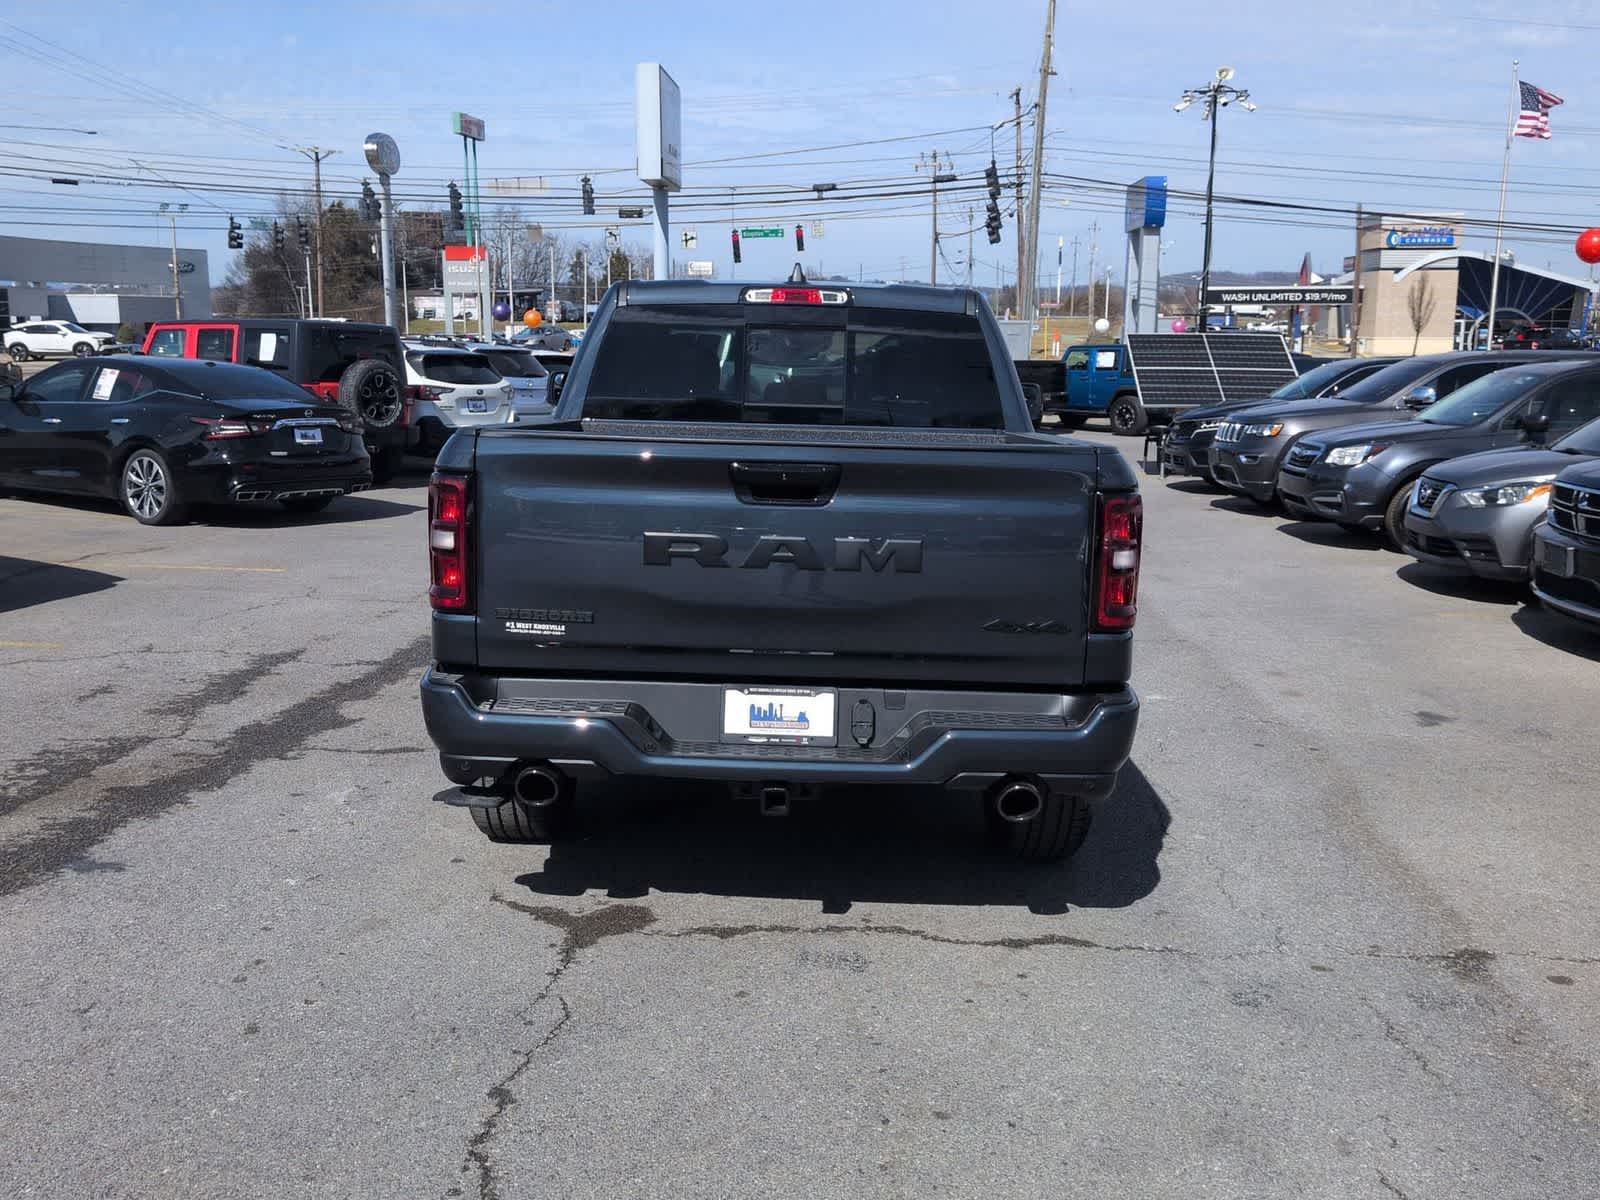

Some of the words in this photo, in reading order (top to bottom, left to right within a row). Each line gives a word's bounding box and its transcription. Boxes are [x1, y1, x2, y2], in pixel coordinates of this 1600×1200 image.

[1221, 293, 1250, 301] WASH
[1252, 292, 1303, 301] UNLIMITED
[643, 531, 923, 573] RAM
[533, 623, 566, 631] KNOXVILLE
